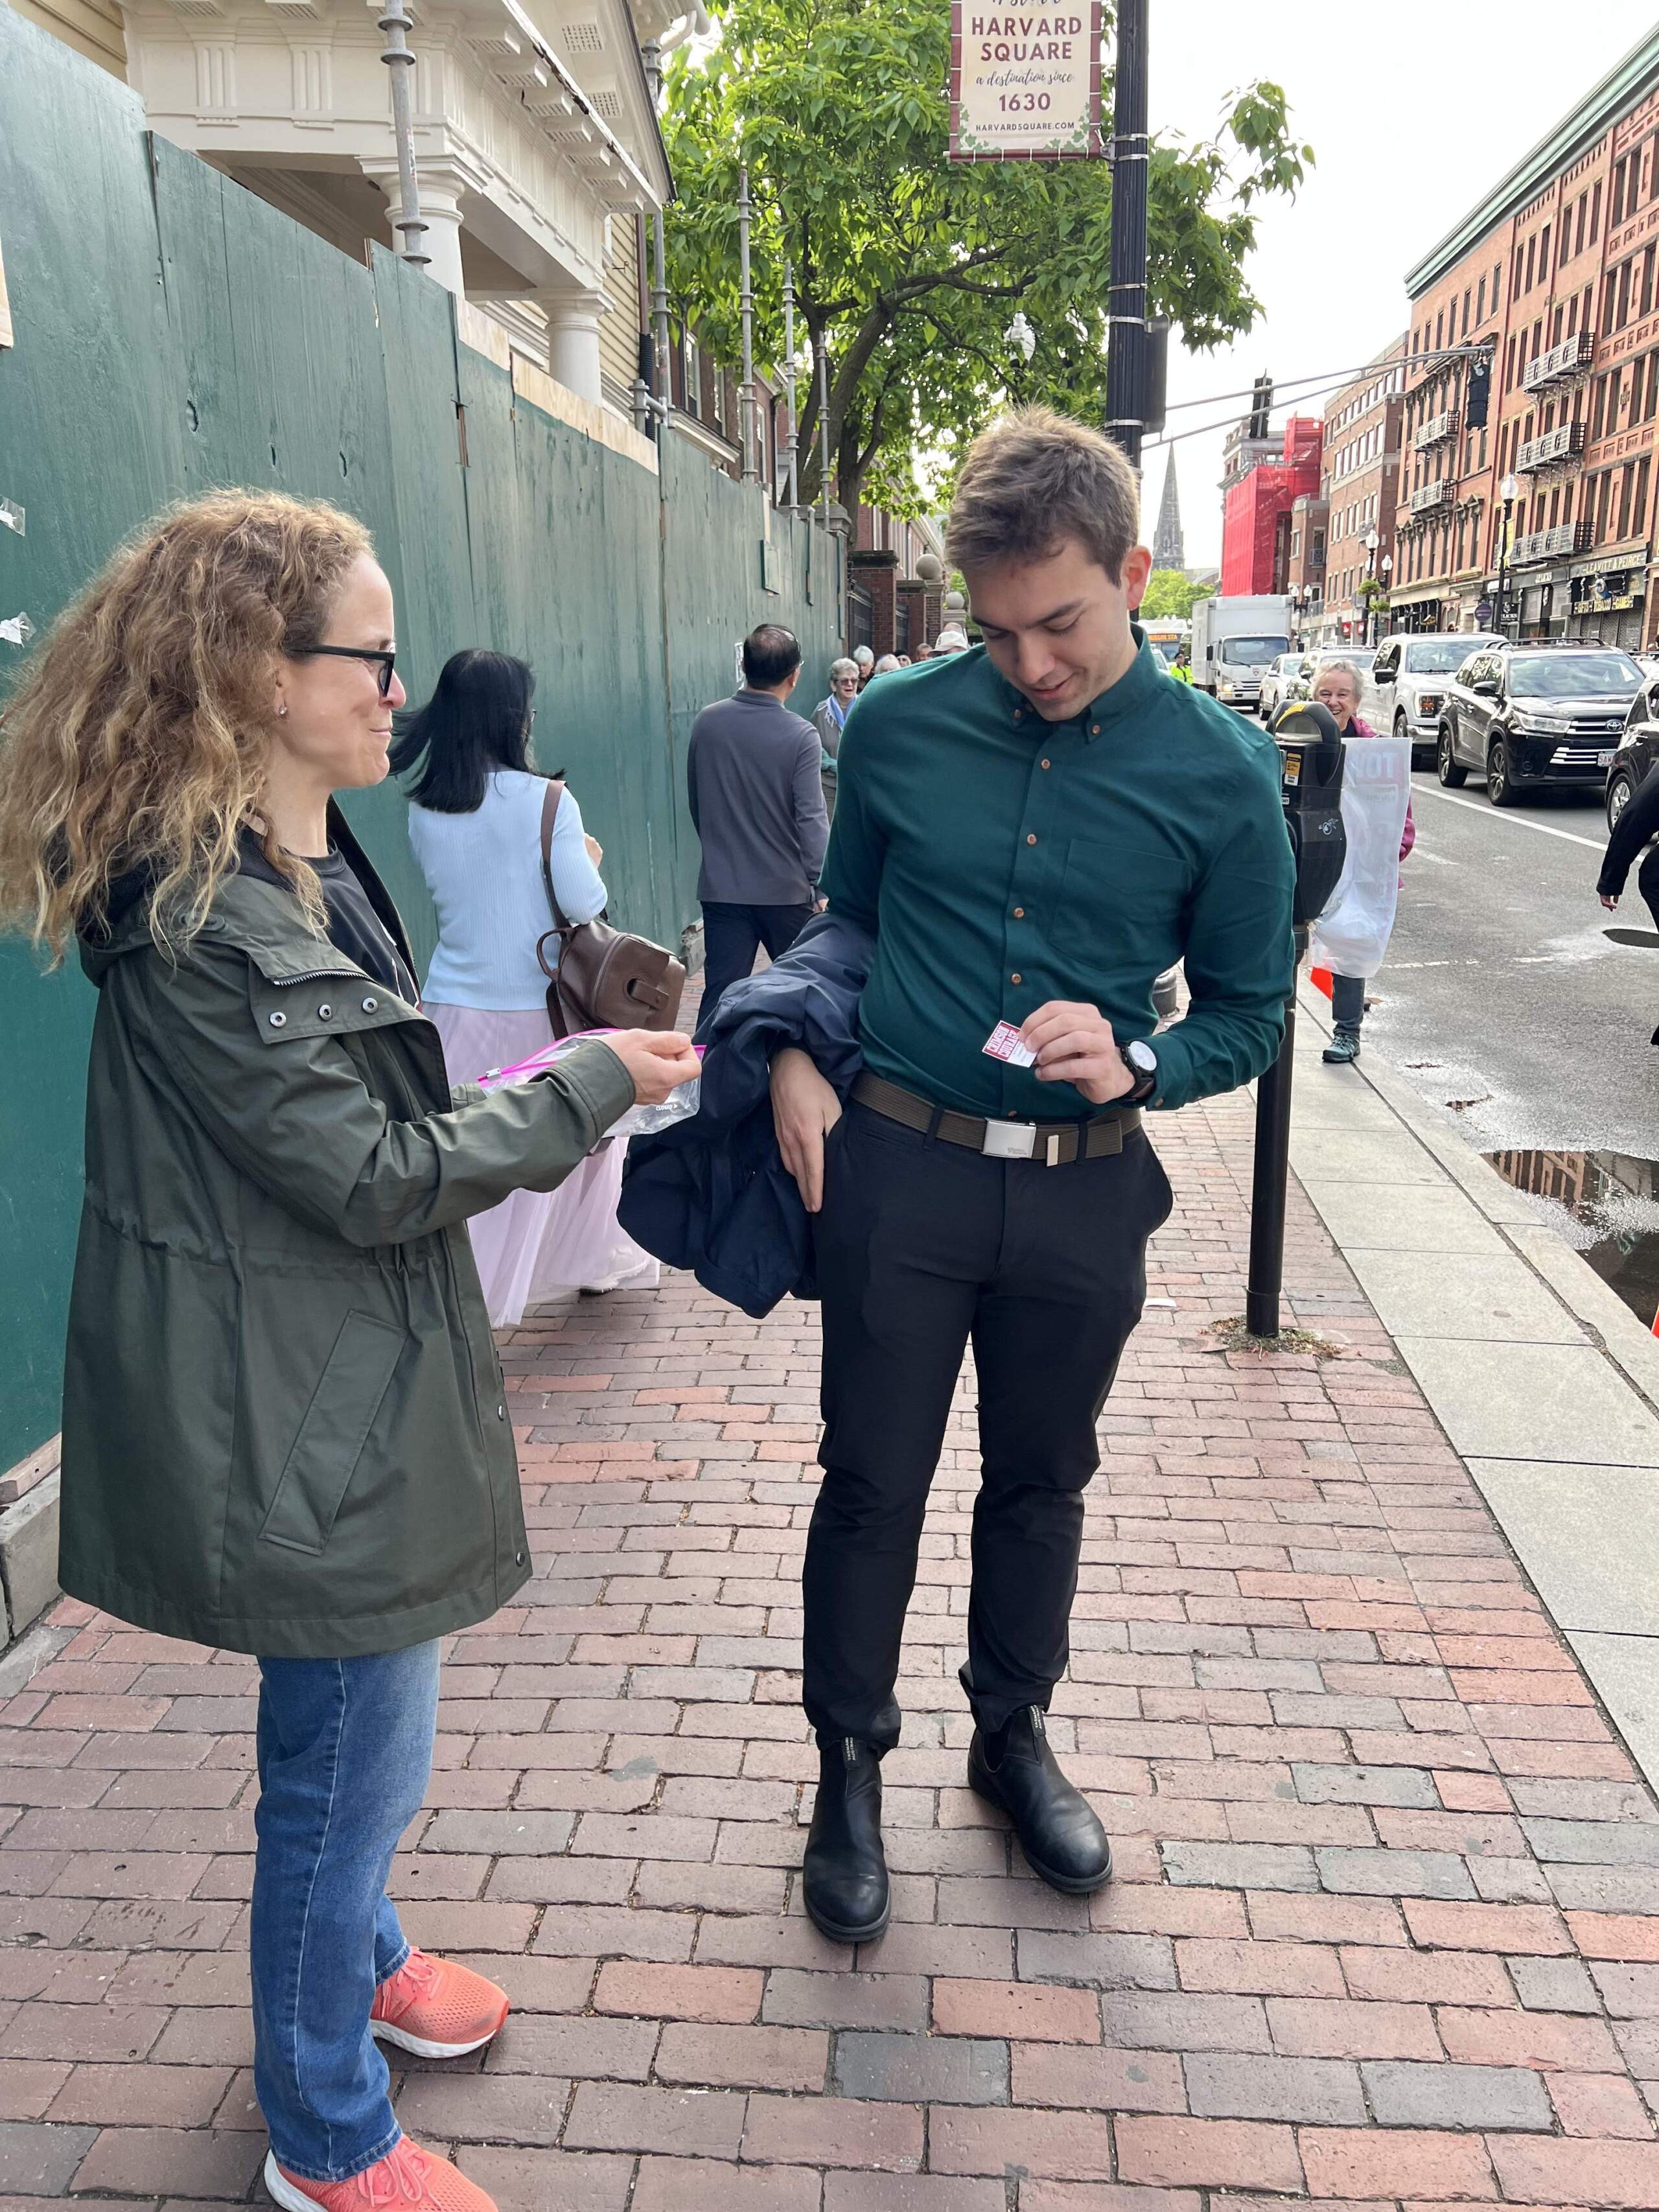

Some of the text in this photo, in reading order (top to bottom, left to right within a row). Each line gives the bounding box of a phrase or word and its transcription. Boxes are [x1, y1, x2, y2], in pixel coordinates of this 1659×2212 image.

[972, 17, 1082, 36] HARVARD
[980, 41, 1072, 62] SQUARE
[976, 68, 1074, 87] a destination since
[999, 92, 1051, 111] 1630
[976, 122, 1074, 132] HARVARDSQUARE.COM
[1586, 559, 1612, 574] LEAVITT
[1618, 554, 1641, 568] PEIRCE
[1599, 755, 1612, 763] 5AW
